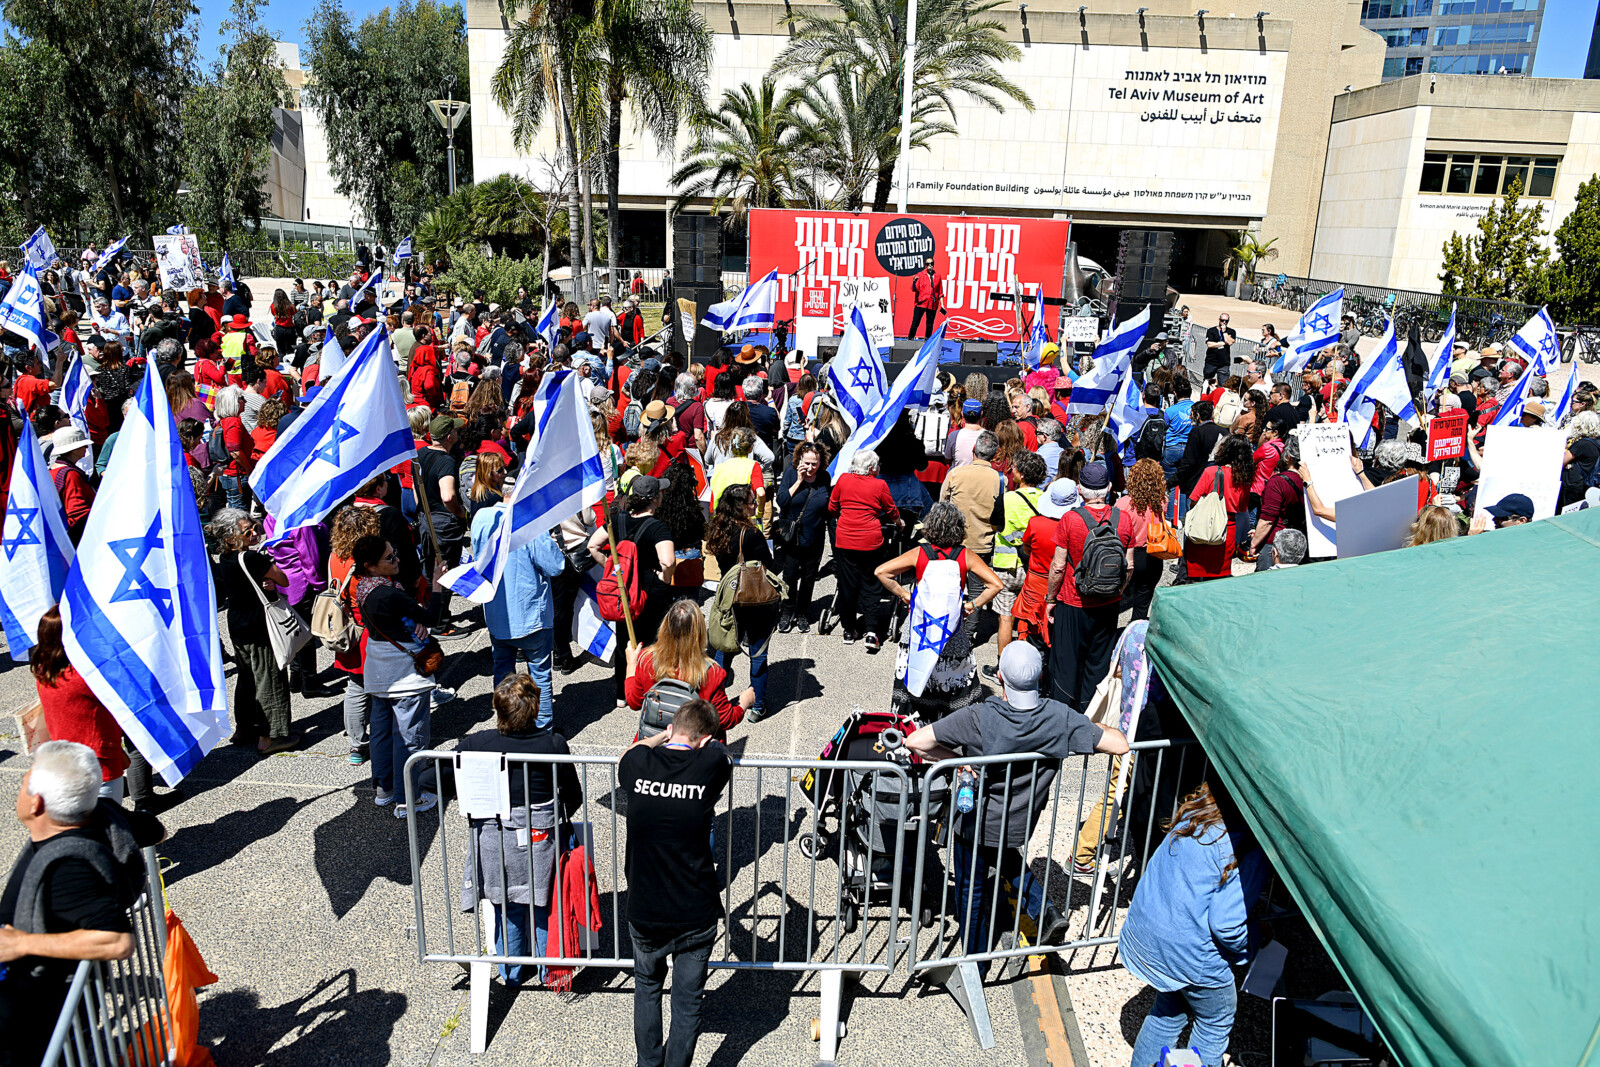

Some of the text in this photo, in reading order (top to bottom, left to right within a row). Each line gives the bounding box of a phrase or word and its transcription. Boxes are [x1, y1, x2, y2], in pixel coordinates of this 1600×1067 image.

[1125, 70, 1267, 85] מוזיאון תל אביב לאמנות
[1109, 87, 1264, 104] Tel Aviv Museum of Art
[1140, 107, 1262, 125] متحف تل أبيب للفنون
[916, 181, 944, 191] Family
[945, 182, 994, 191] Foundation
[995, 184, 1029, 194] Building
[1133, 189, 1163, 198] פאולסון
[1164, 191, 1193, 199] משפחת
[795, 217, 869, 248] תרבות
[885, 223, 922, 239] כנס חירום
[945, 222, 1021, 254] תרבות
[877, 236, 932, 256] לעולם התרבות
[797, 246, 865, 277] חירות
[889, 255, 924, 270] הישראלי
[947, 251, 1015, 282] חירות
[863, 280, 879, 292] NO
[634, 779, 706, 800] SECURITY
